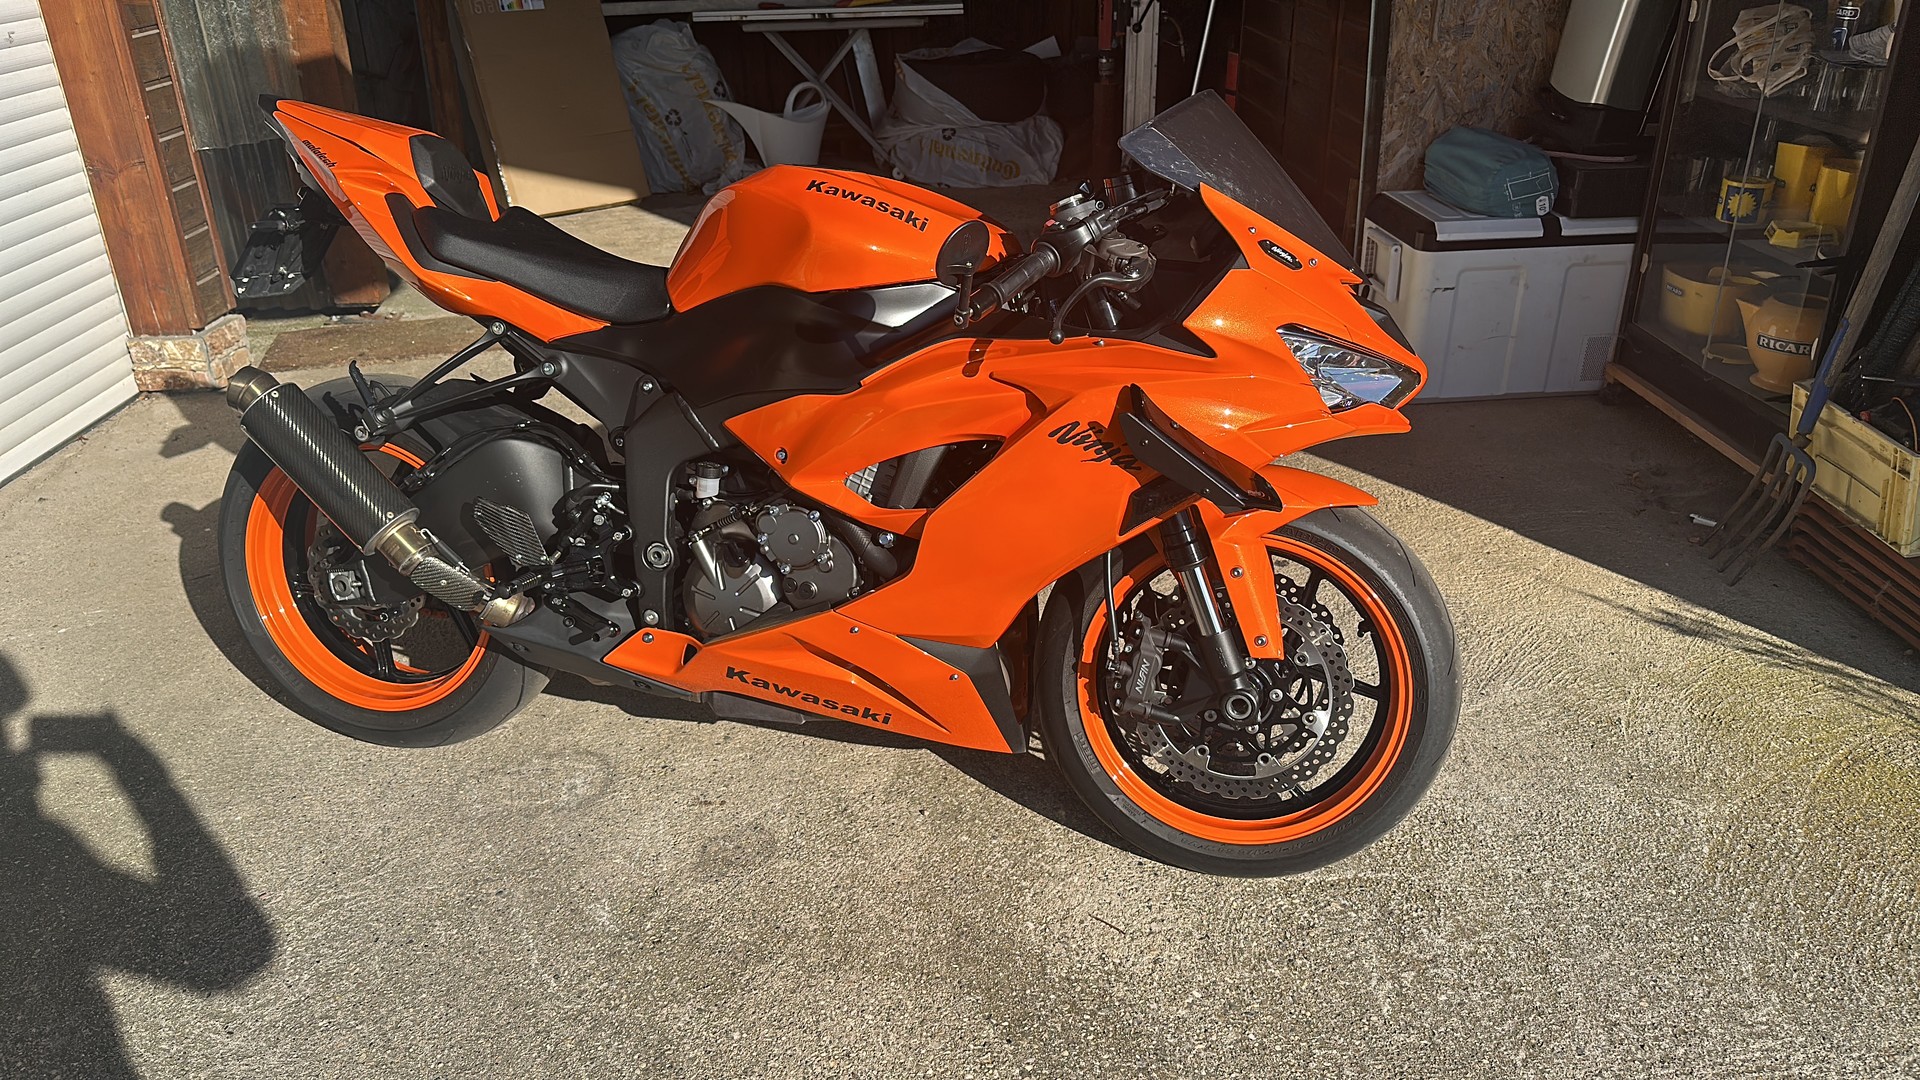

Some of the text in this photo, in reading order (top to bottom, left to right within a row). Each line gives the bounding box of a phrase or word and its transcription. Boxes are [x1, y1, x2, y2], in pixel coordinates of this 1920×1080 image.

[806, 179, 929, 232] Kawasaki
[1759, 335, 1810, 355] RICAR
[1047, 420, 1142, 471] Ninja
[725, 665, 893, 725] Kawasaki
